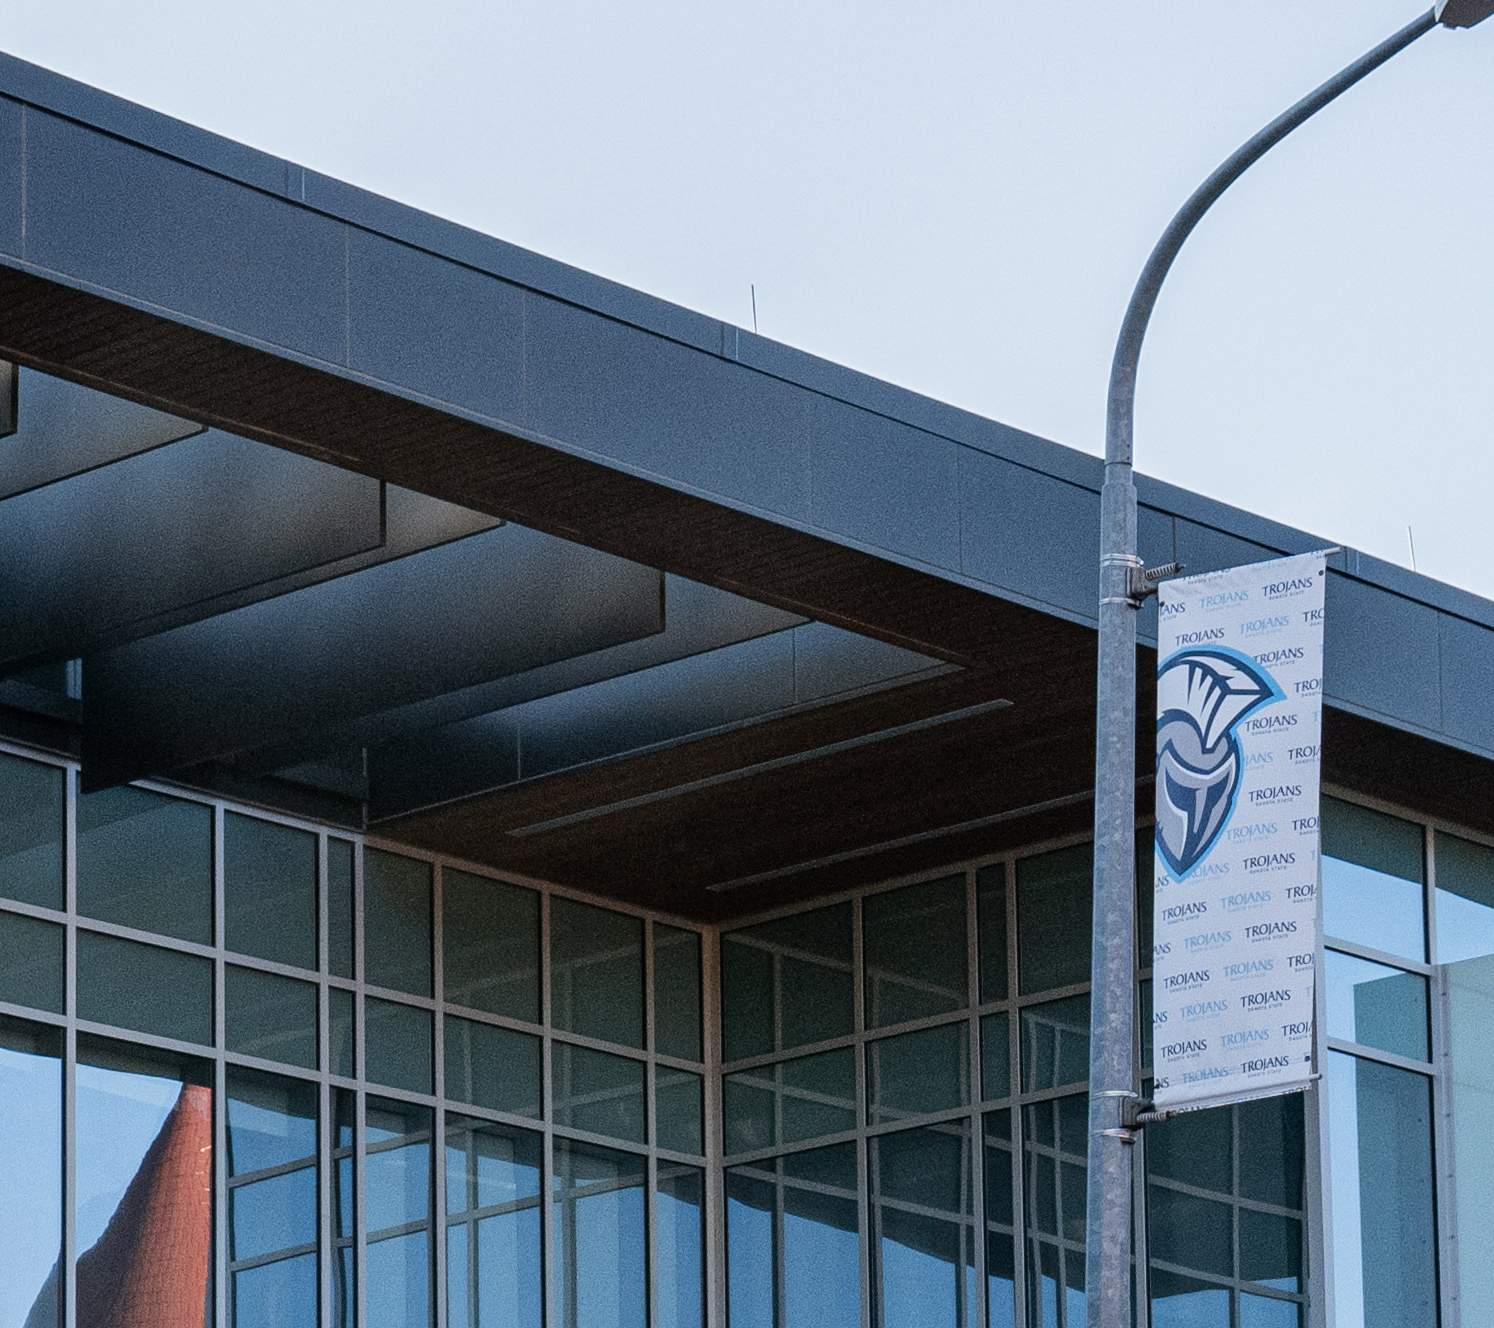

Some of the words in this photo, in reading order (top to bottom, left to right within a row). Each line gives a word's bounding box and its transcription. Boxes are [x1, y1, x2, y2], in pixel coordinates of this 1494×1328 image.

[1262, 577, 1313, 597] TROJANS
[1200, 591, 1249, 609] TROJANS
[1240, 616, 1289, 635] TROJANS
[1175, 628, 1226, 646] TROJANS
[1245, 714, 1298, 732] TROJANS
[1249, 785, 1302, 802] TROJANS
[1226, 822, 1278, 840] TROJANS
[1243, 852, 1296, 870] TROJANS
[1221, 891, 1271, 909] TROJANS
[1161, 901, 1207, 921] TROJANS
[1245, 921, 1297, 938] TROJANS
[1184, 931, 1232, 949] TROJANS
[1223, 959, 1273, 977] TROJANS
[1163, 970, 1210, 989] TROJANS
[1240, 989, 1291, 1007] TROJANS
[1180, 999, 1228, 1018] TROJANS
[1221, 1029, 1269, 1047] TROJANS
[1161, 1039, 1207, 1058] TROJANS
[1240, 1055, 1289, 1073] TROJANS
